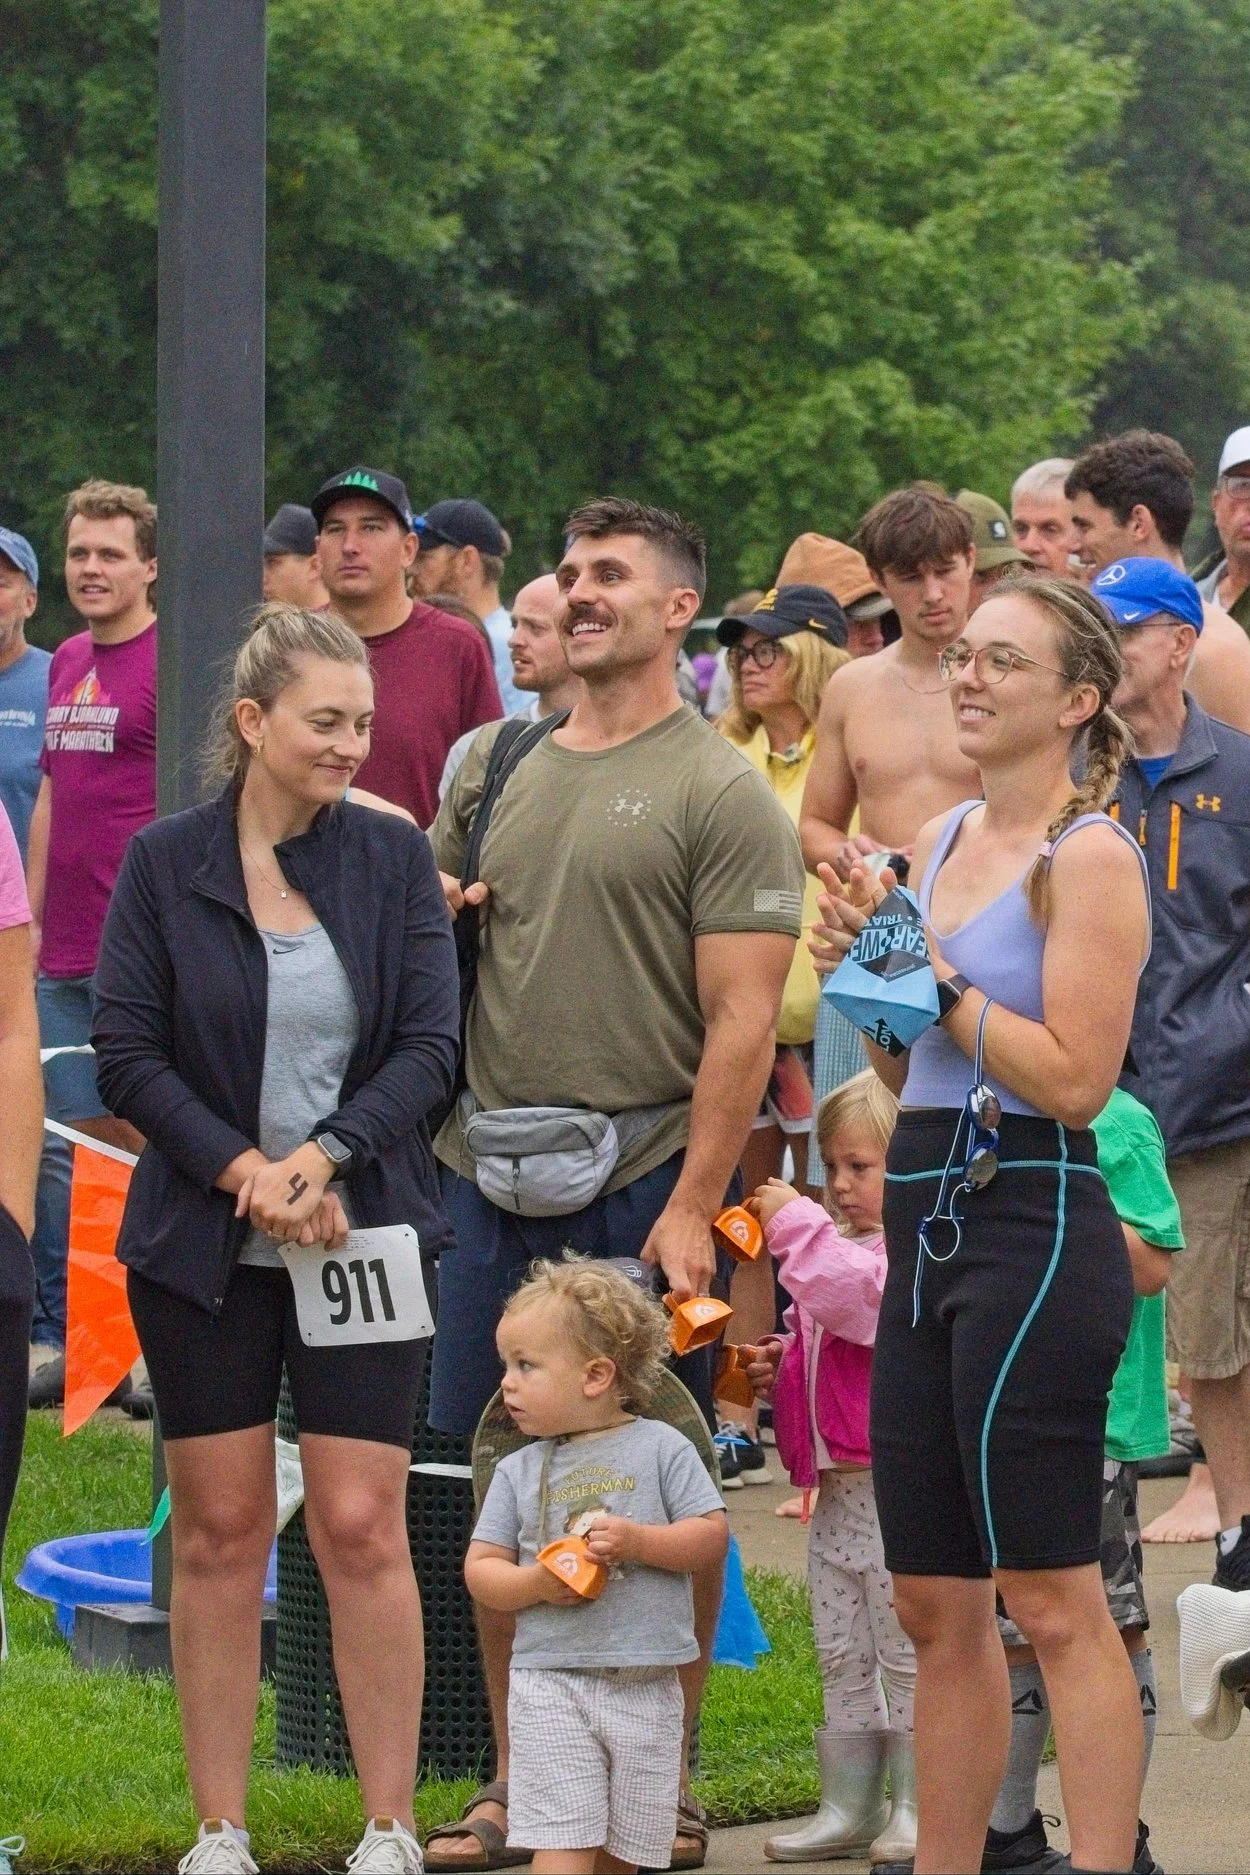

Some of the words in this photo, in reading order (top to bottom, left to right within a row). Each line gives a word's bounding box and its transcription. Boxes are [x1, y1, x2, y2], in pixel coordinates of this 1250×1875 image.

[864, 914, 903, 926] TRIAT
[890, 925, 927, 957] EAR
[286, 1172, 309, 1206] 4
[321, 1258, 397, 1326] 911
[545, 1476, 635, 1506] FISHERMAN
[564, 1466, 614, 1486] FUTURE
